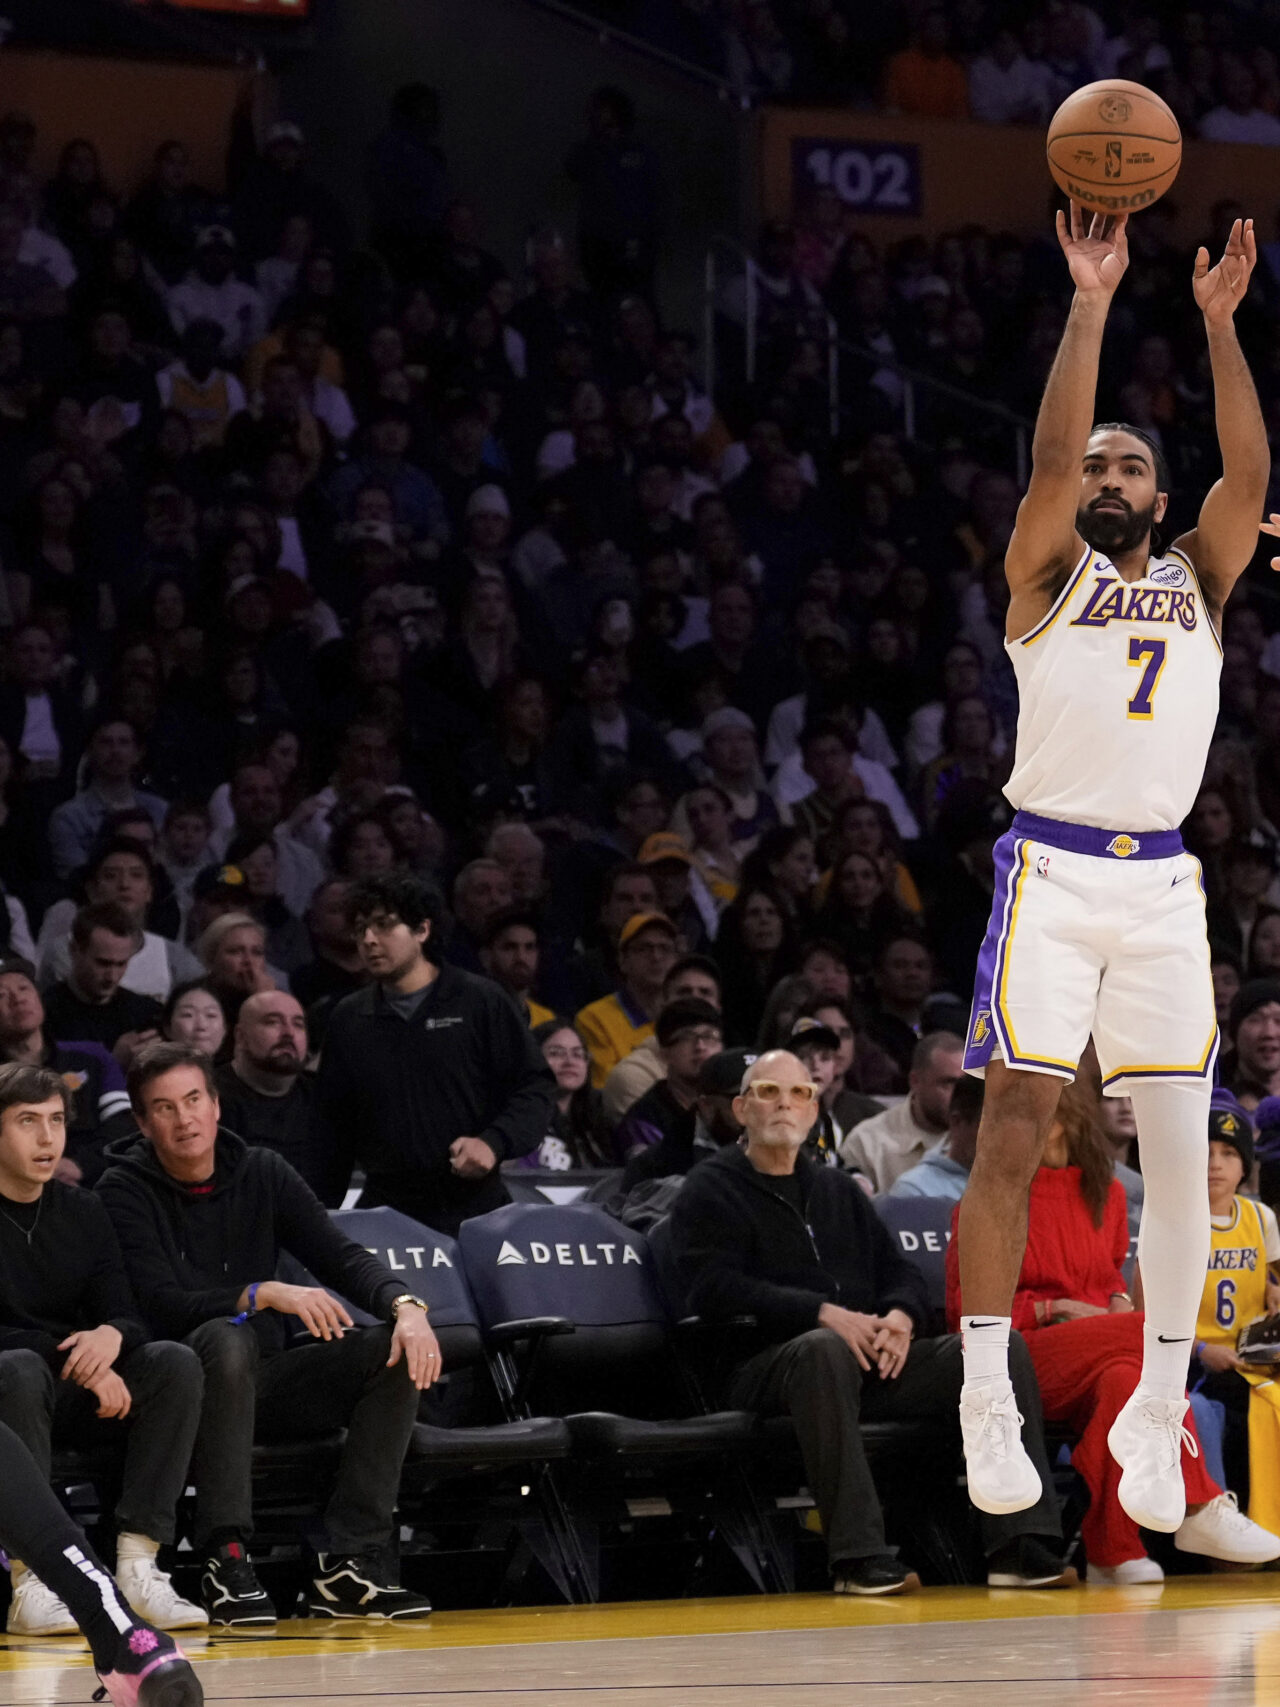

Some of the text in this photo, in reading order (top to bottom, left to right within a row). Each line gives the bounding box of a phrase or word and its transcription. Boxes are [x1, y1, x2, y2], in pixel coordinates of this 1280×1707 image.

[805, 147, 911, 206] 102
[1152, 569, 1183, 584] bibigo
[1069, 577, 1198, 632] LAKERS
[1127, 635, 1169, 721] 7
[1108, 839, 1138, 853] LAKERS
[529, 1240, 642, 1266] DELTA
[898, 1230, 951, 1252] DE
[365, 1246, 453, 1270] LTA
[1216, 1278, 1236, 1330] 6
